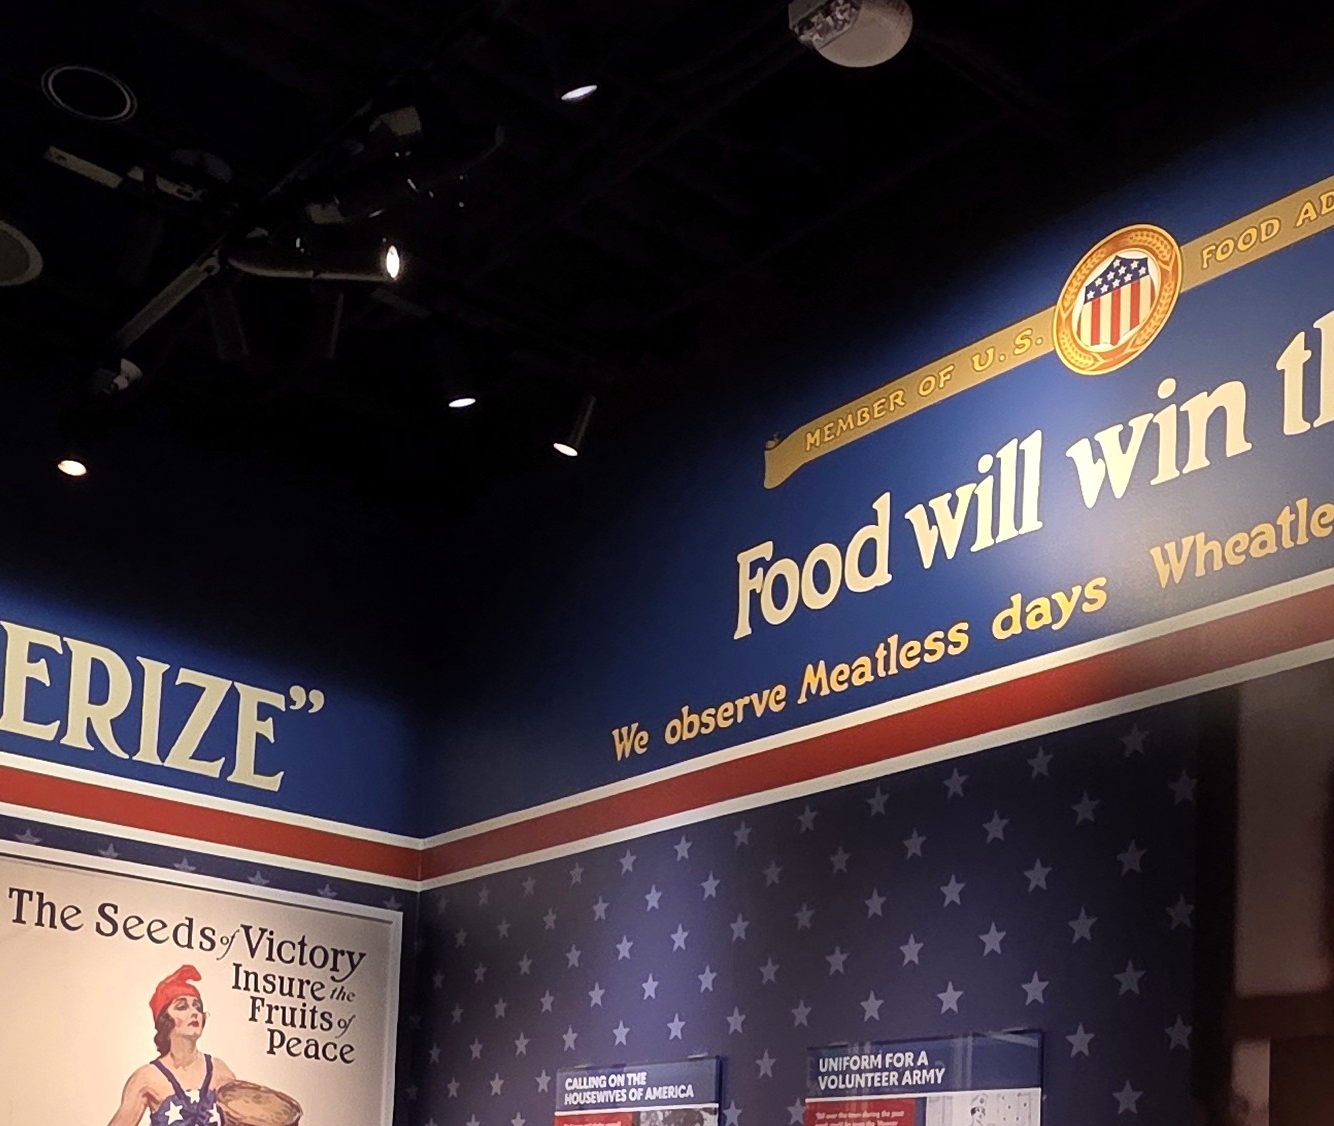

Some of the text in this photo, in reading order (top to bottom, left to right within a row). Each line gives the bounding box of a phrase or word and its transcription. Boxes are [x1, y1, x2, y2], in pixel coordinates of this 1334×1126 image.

[1201, 217, 1280, 269] FOOD
[804, 389, 907, 451] MEMBER
[918, 364, 955, 396] OF
[733, 491, 892, 640] Food
[905, 429, 1043, 570] will
[1065, 372, 1253, 509] win
[611, 722, 649, 762] We
[665, 681, 787, 746] observe
[798, 622, 969, 704] Meatless
[992, 576, 1108, 640] days
[8, 886, 366, 982] The Seeds of Victory
[231, 963, 355, 1003] Insure the
[249, 996, 356, 1039] Fruits of
[266, 1028, 356, 1064] Peace
[819, 1050, 929, 1073] UNIFORM FOR A
[564, 1084, 694, 1105] HOUSEWIVES OF AMERICA
[565, 1072, 647, 1091] CALLING ON THE
[818, 1068, 945, 1090] VOLUNTEER ARMY
